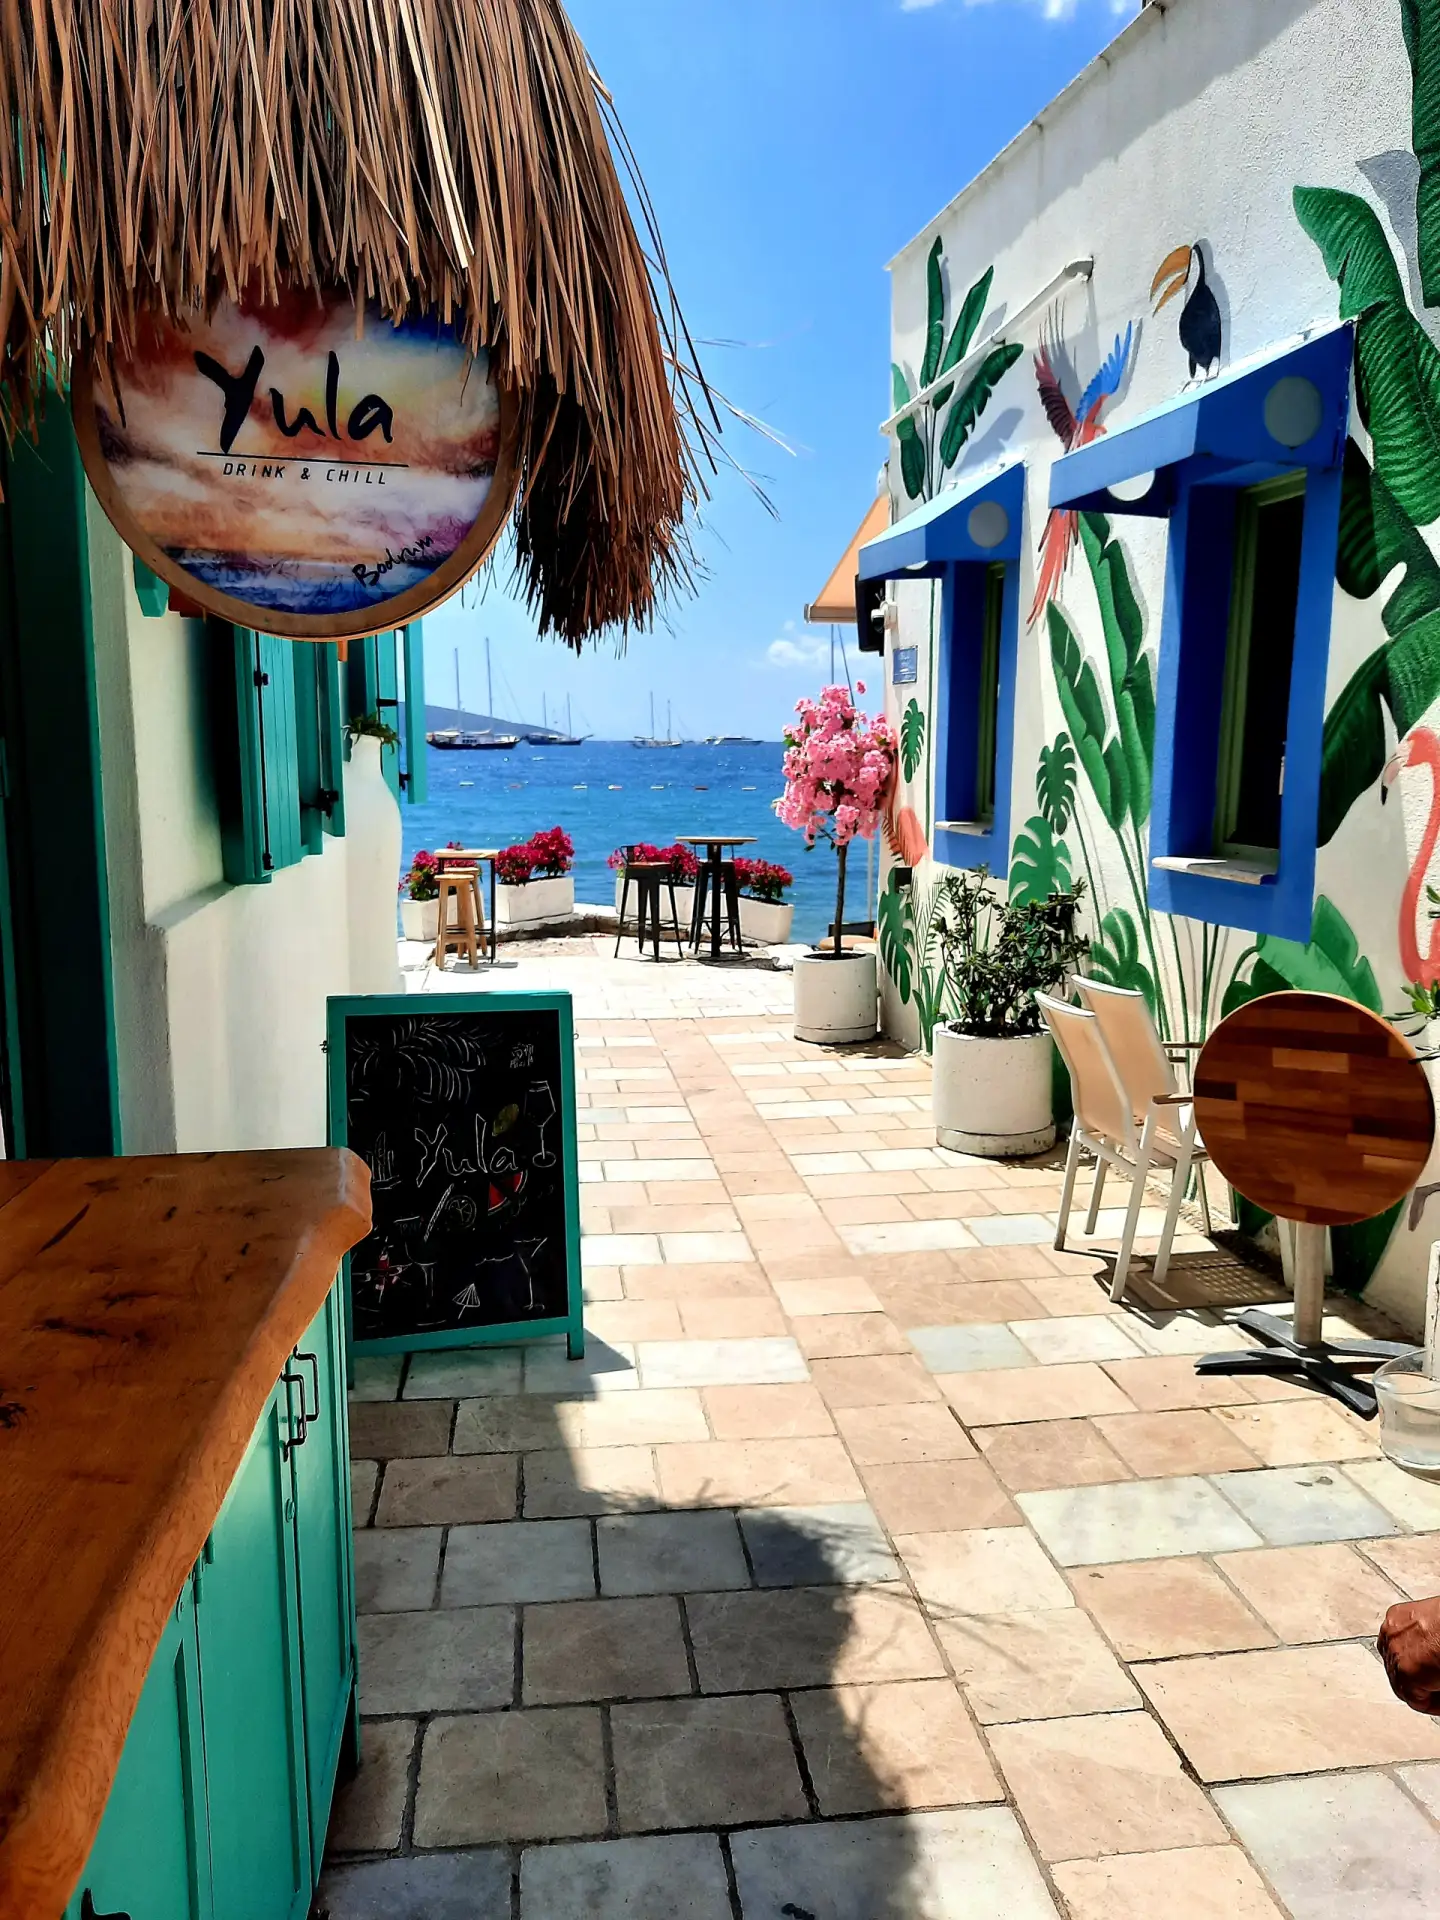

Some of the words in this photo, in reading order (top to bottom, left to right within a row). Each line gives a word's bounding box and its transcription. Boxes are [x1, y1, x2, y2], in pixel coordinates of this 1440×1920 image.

[194, 345, 393, 454] Yula
[223, 461, 285, 479] DRINK
[300, 467, 311, 481] &
[326, 468, 387, 485] CHILL
[352, 535, 434, 588] Bodrum
[414, 1113, 519, 1188] Yula
